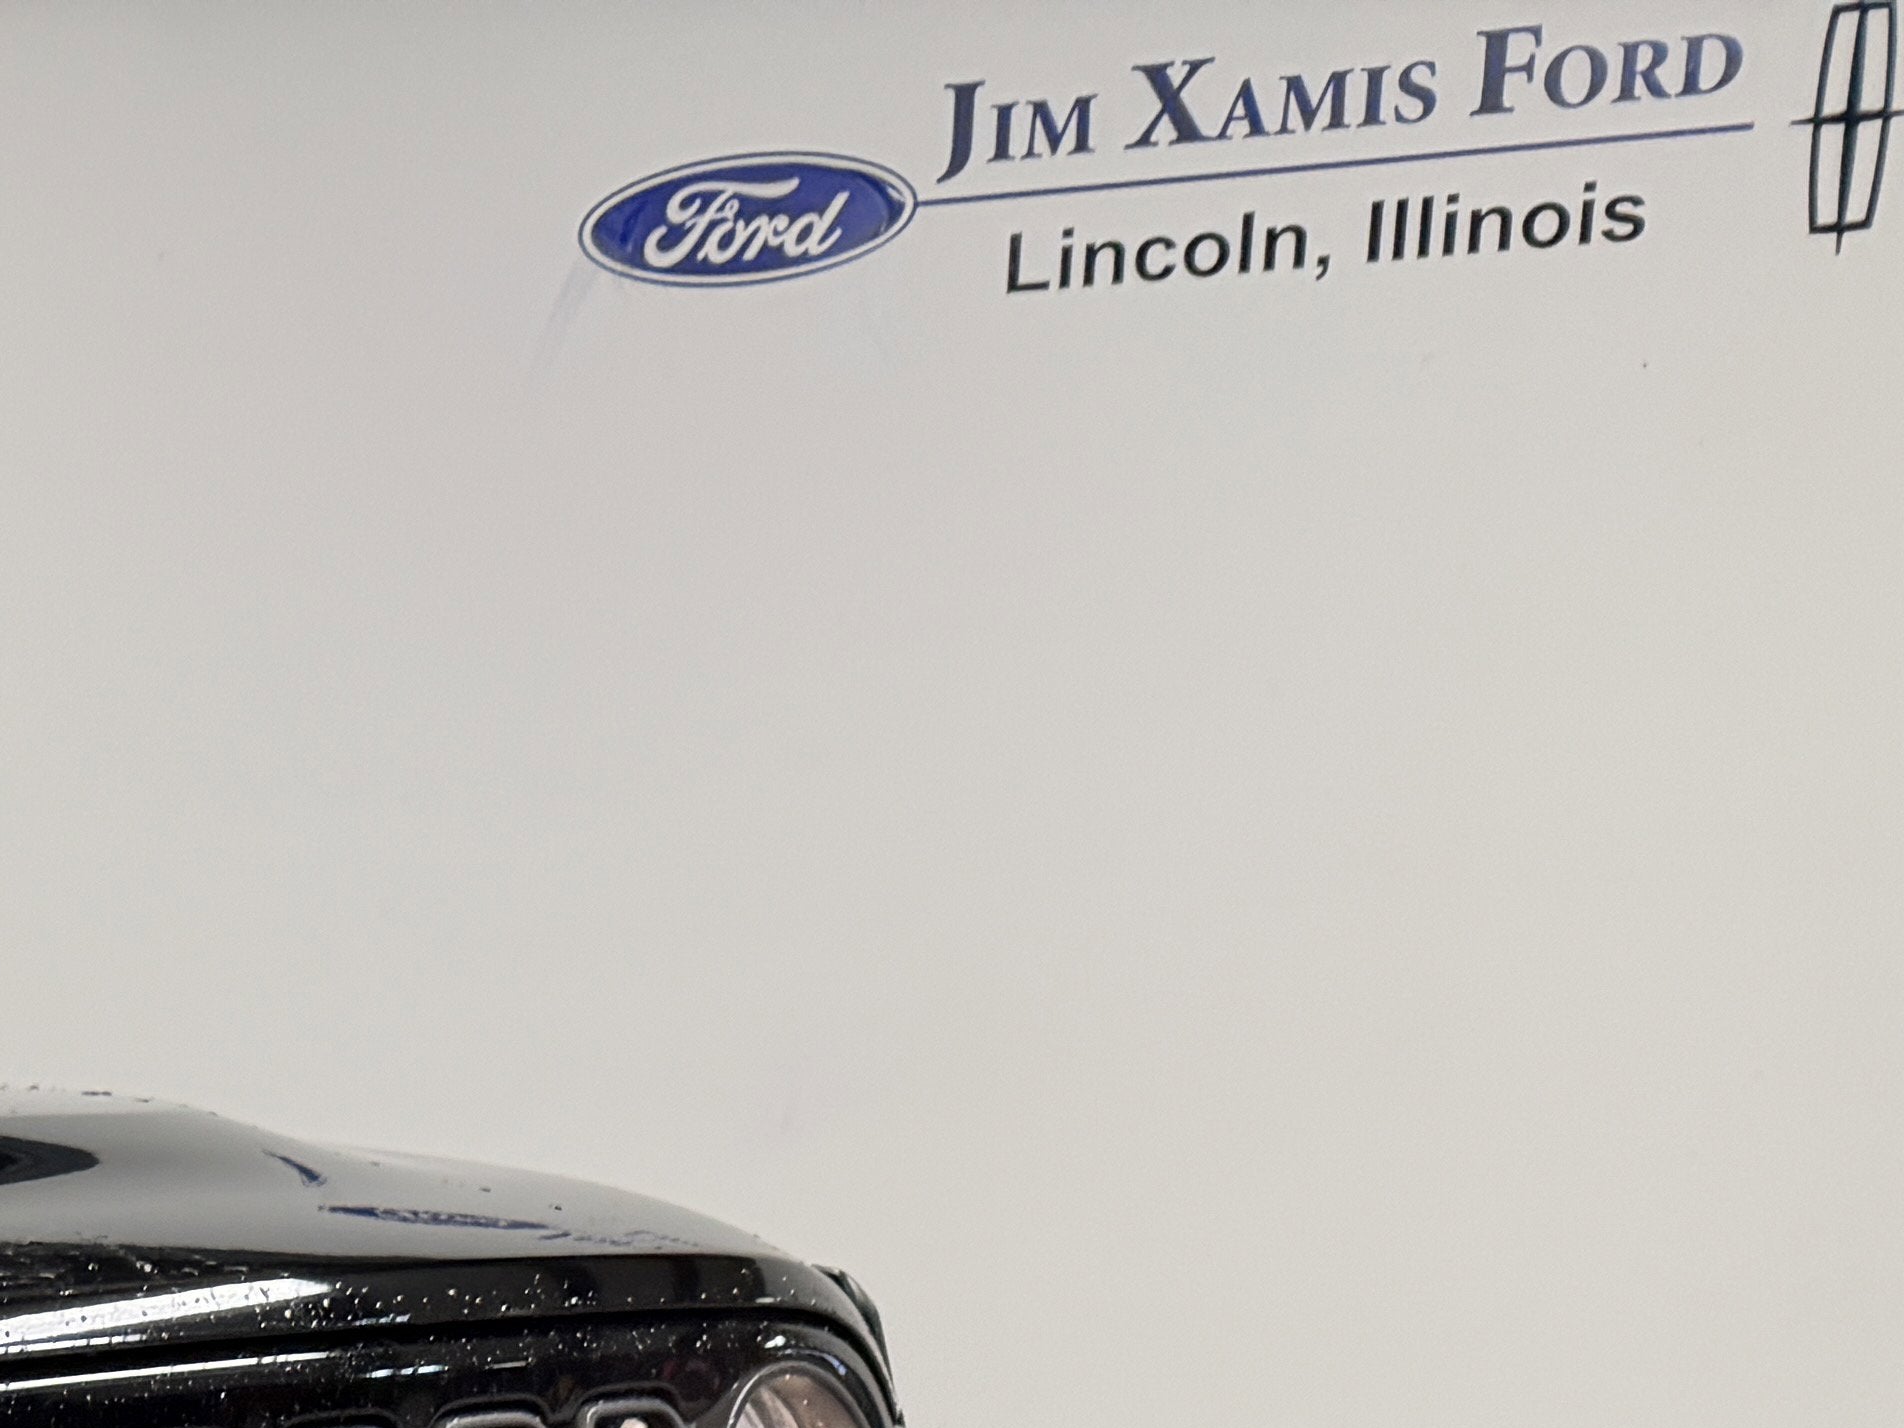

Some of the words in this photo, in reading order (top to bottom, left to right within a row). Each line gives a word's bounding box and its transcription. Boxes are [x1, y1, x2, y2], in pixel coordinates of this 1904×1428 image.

[935, 79, 1099, 184] JIM
[1123, 56, 1438, 151] XAMIS
[1469, 23, 1744, 117] FORD
[644, 176, 850, 268] Ford
[1005, 210, 1331, 295] Lincoln,
[1365, 180, 1647, 264] Illinois
